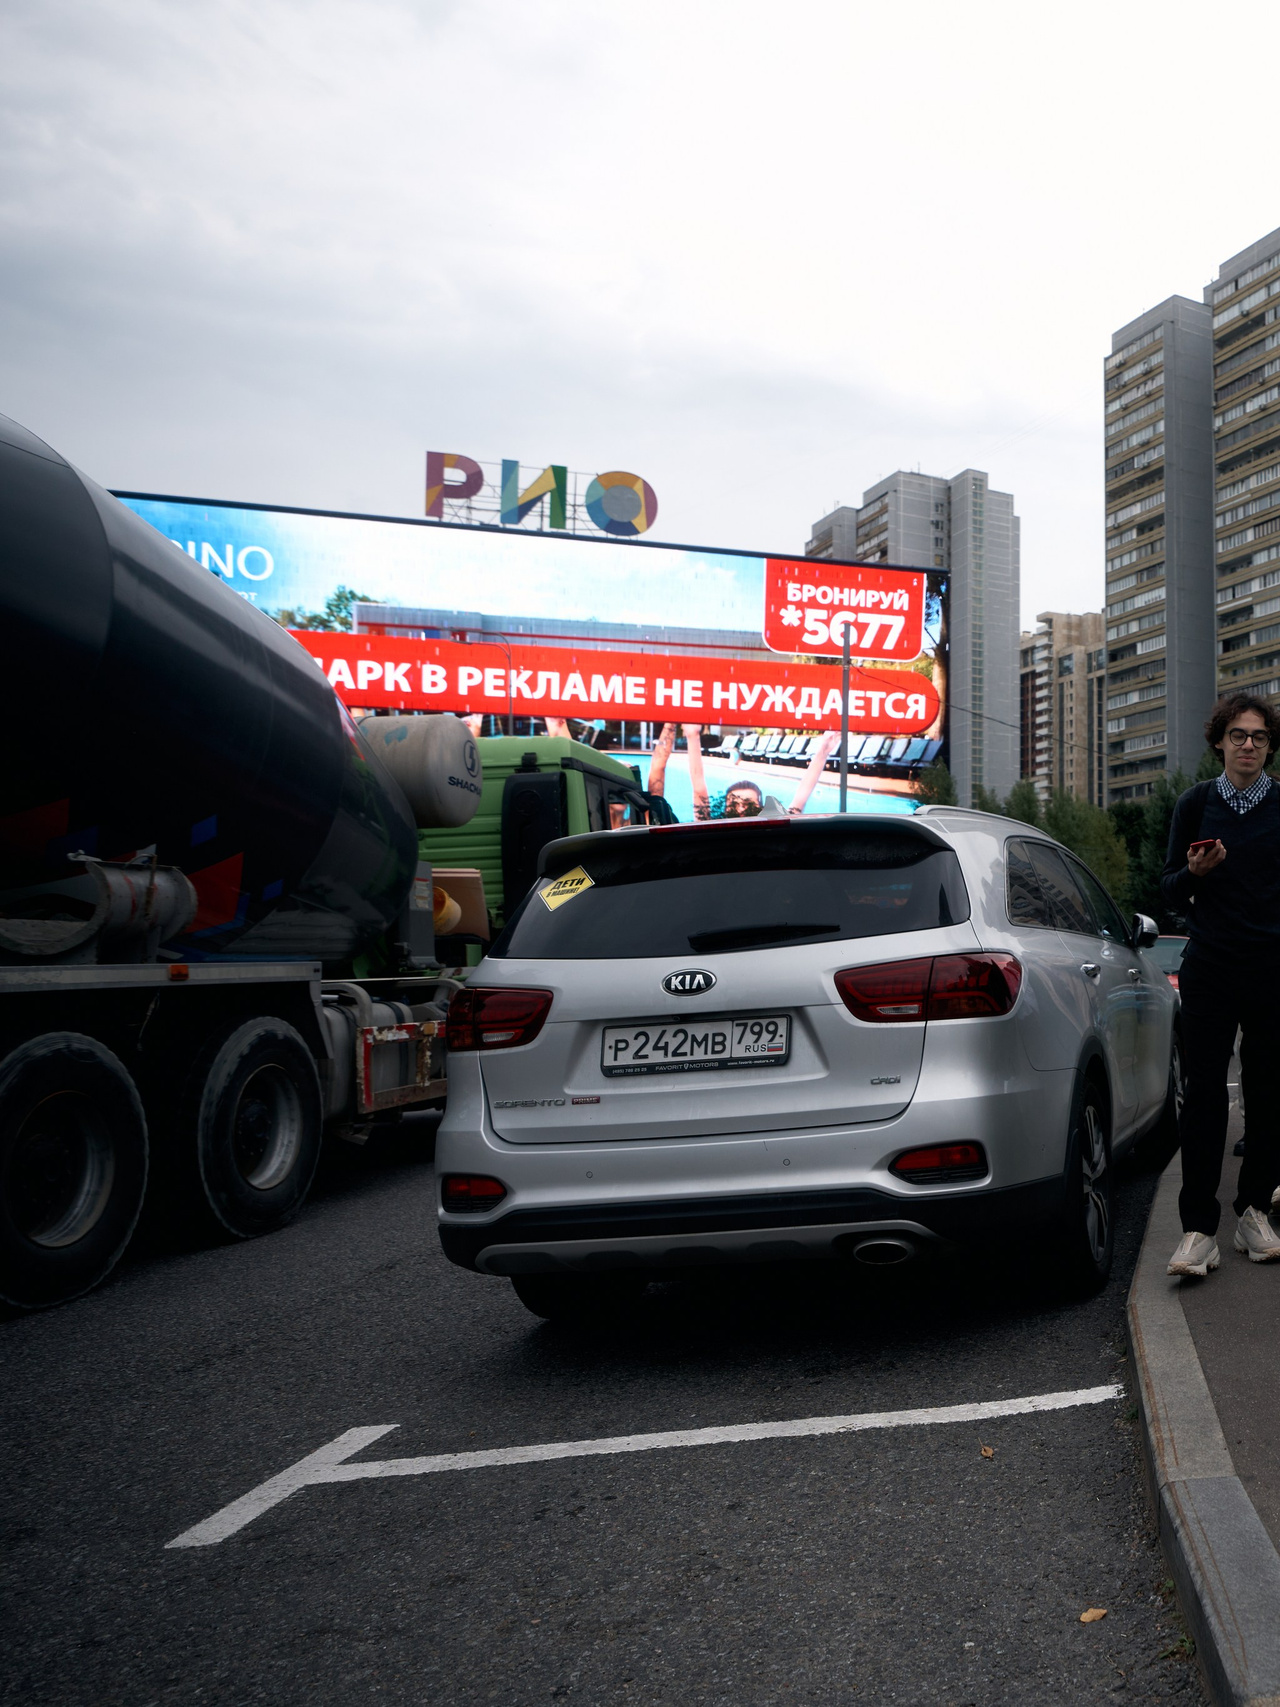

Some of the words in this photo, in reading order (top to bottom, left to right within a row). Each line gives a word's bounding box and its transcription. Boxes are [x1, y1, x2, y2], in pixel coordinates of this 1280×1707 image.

[425, 451, 658, 536] РИО
[787, 583, 909, 611] БРОНИРУЙ
[313, 657, 412, 693] АРК
[421, 663, 448, 694] В
[458, 666, 646, 705] РЕКЛАМЕ
[655, 678, 703, 708] НЕ
[712, 681, 926, 720] НУЖДАЕТСЯ
[550, 878, 586, 891] ДЕТИ
[670, 974, 707, 991] KIA
[735, 1021, 779, 1045] 799
[744, 1043, 767, 1053] RUS
[494, 1098, 566, 1109] SORENTO
